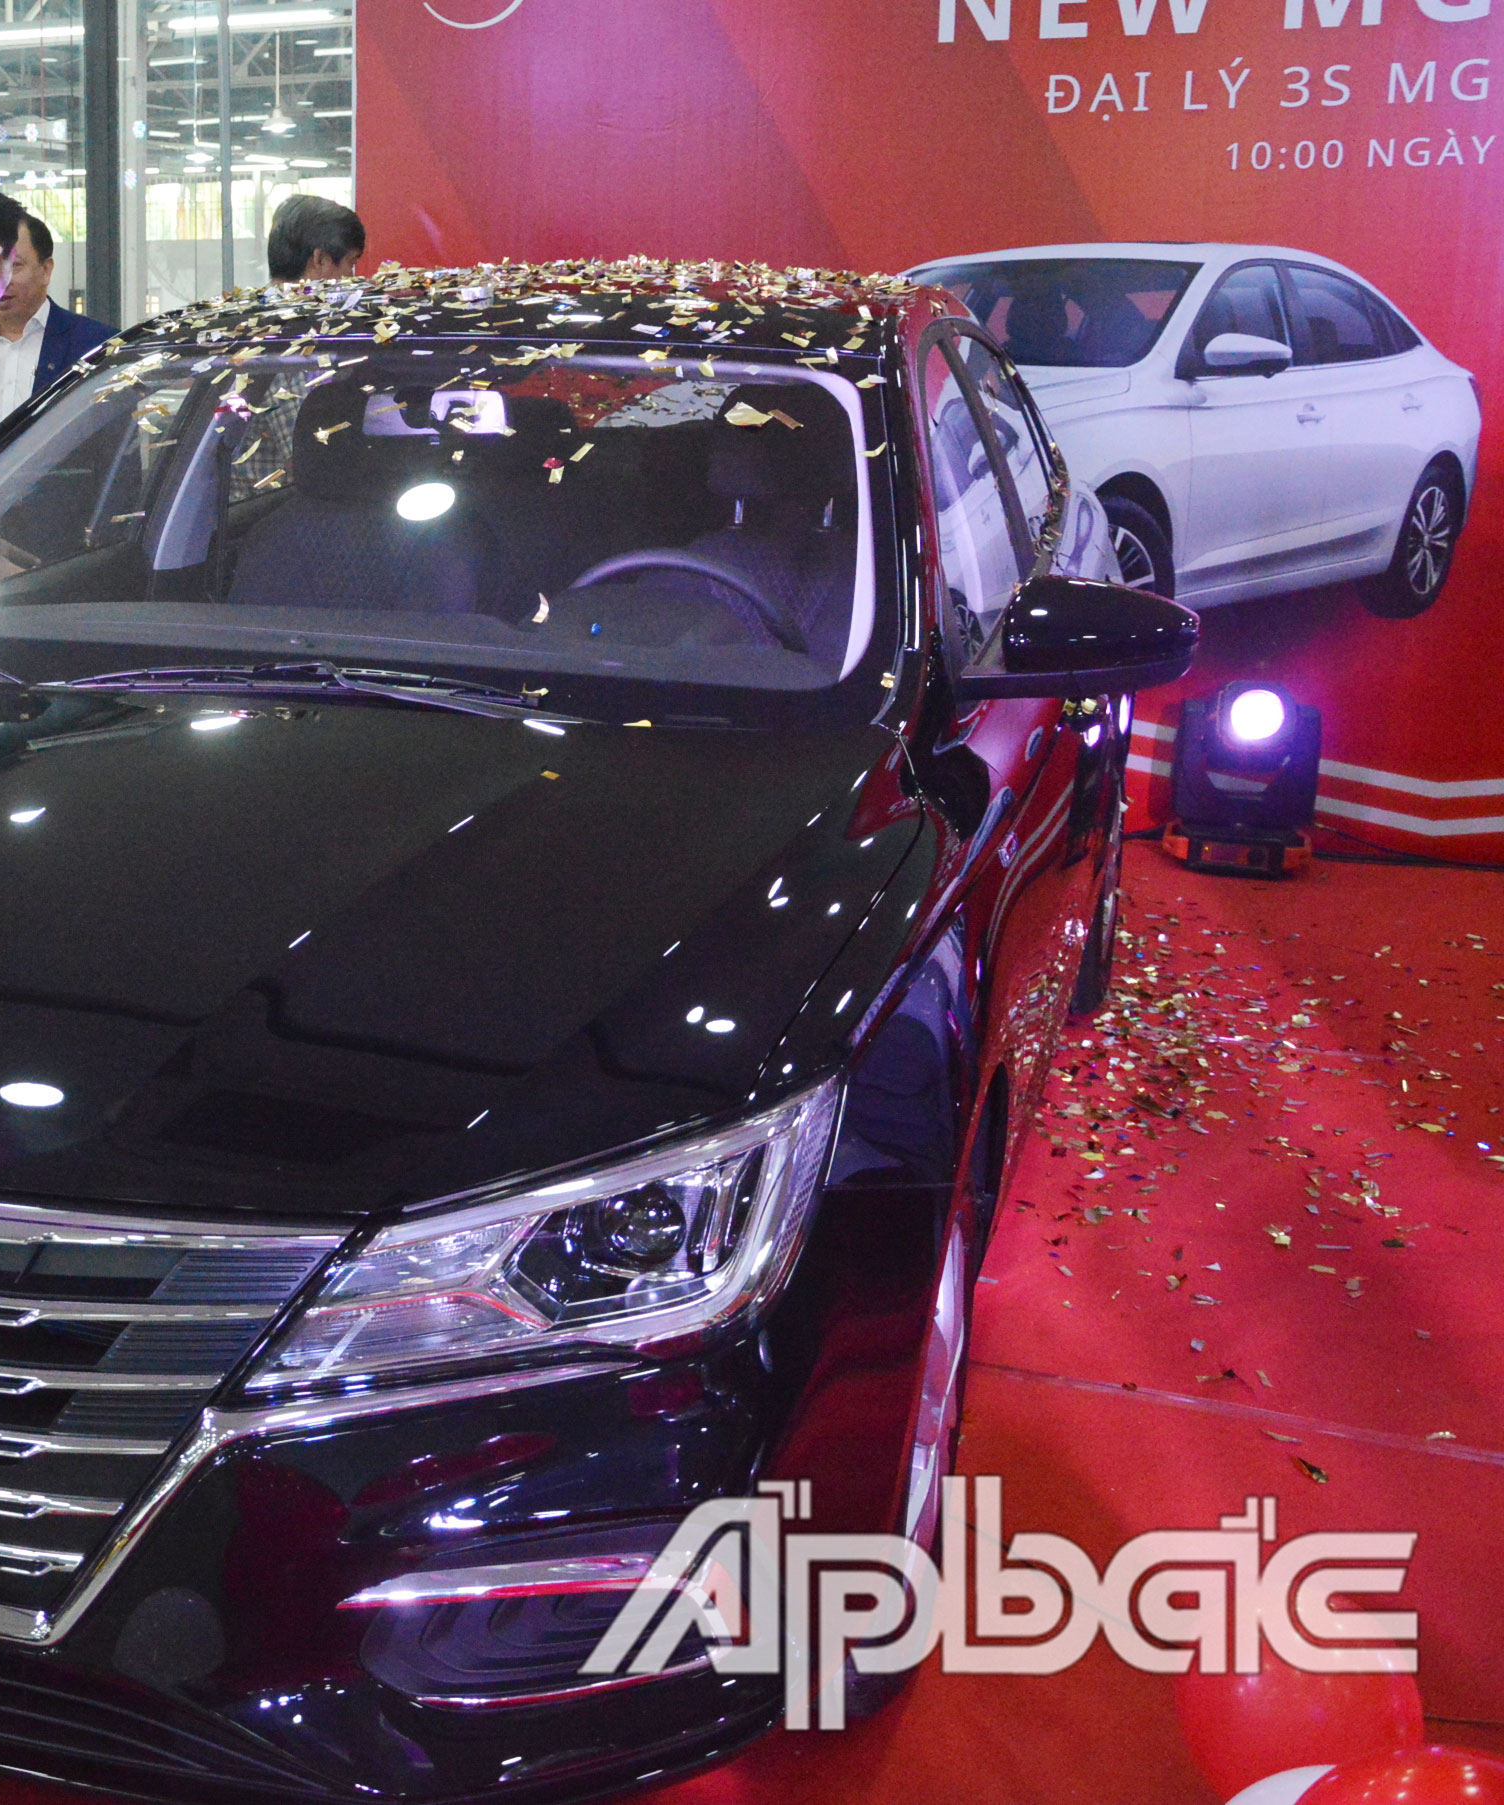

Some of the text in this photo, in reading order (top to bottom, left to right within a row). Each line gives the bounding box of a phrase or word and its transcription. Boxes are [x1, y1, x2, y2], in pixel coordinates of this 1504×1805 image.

[1044, 57, 1491, 121] ĐẠI LÝ 3S MG
[1224, 128, 1497, 171] 10:00 NGÀY
